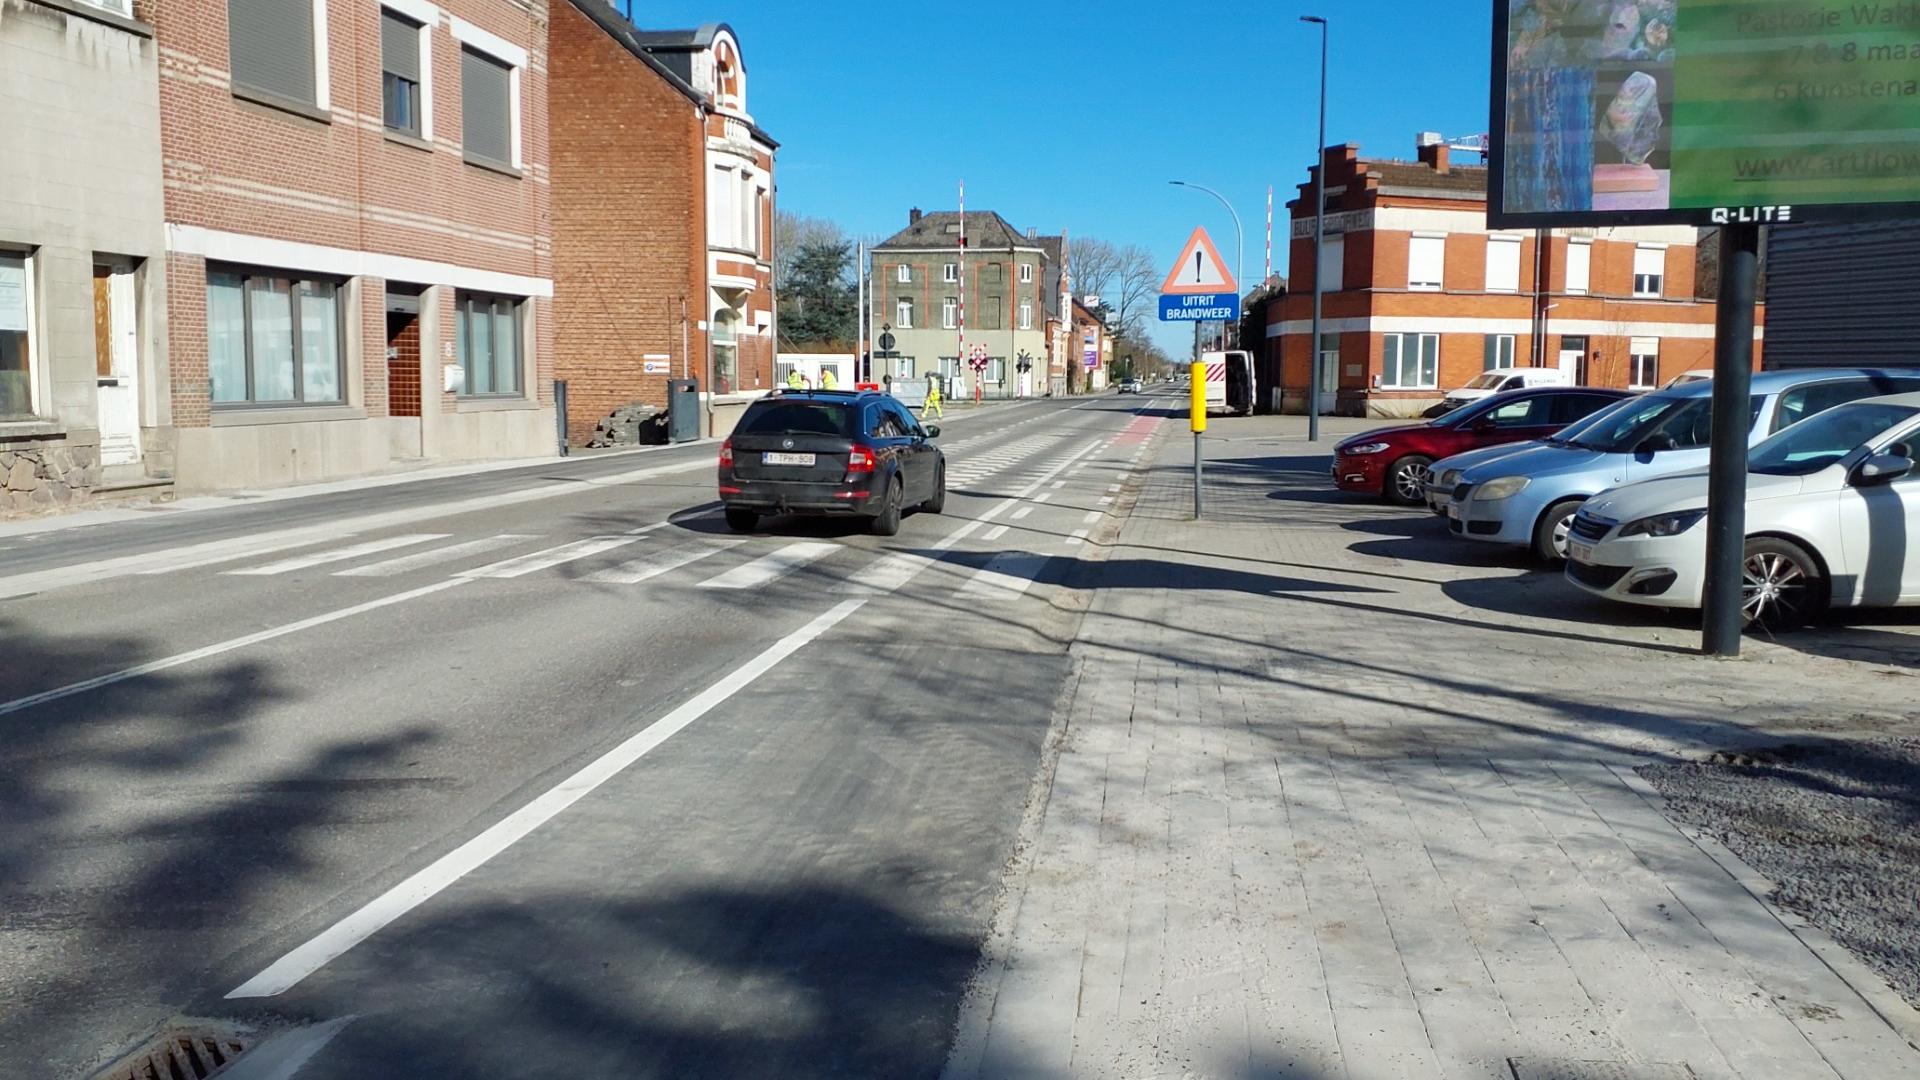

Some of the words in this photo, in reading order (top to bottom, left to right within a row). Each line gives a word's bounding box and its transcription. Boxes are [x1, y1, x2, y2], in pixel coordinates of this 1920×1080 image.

[1736, 7, 1841, 32] Pastorie
[1840, 41, 1857, 62] 8
[1774, 82, 1788, 100] 6
[1711, 205, 1791, 224] Q-LITE
[1182, 295, 1215, 306] UITRIT
[1166, 307, 1232, 319] BRANDWEER
